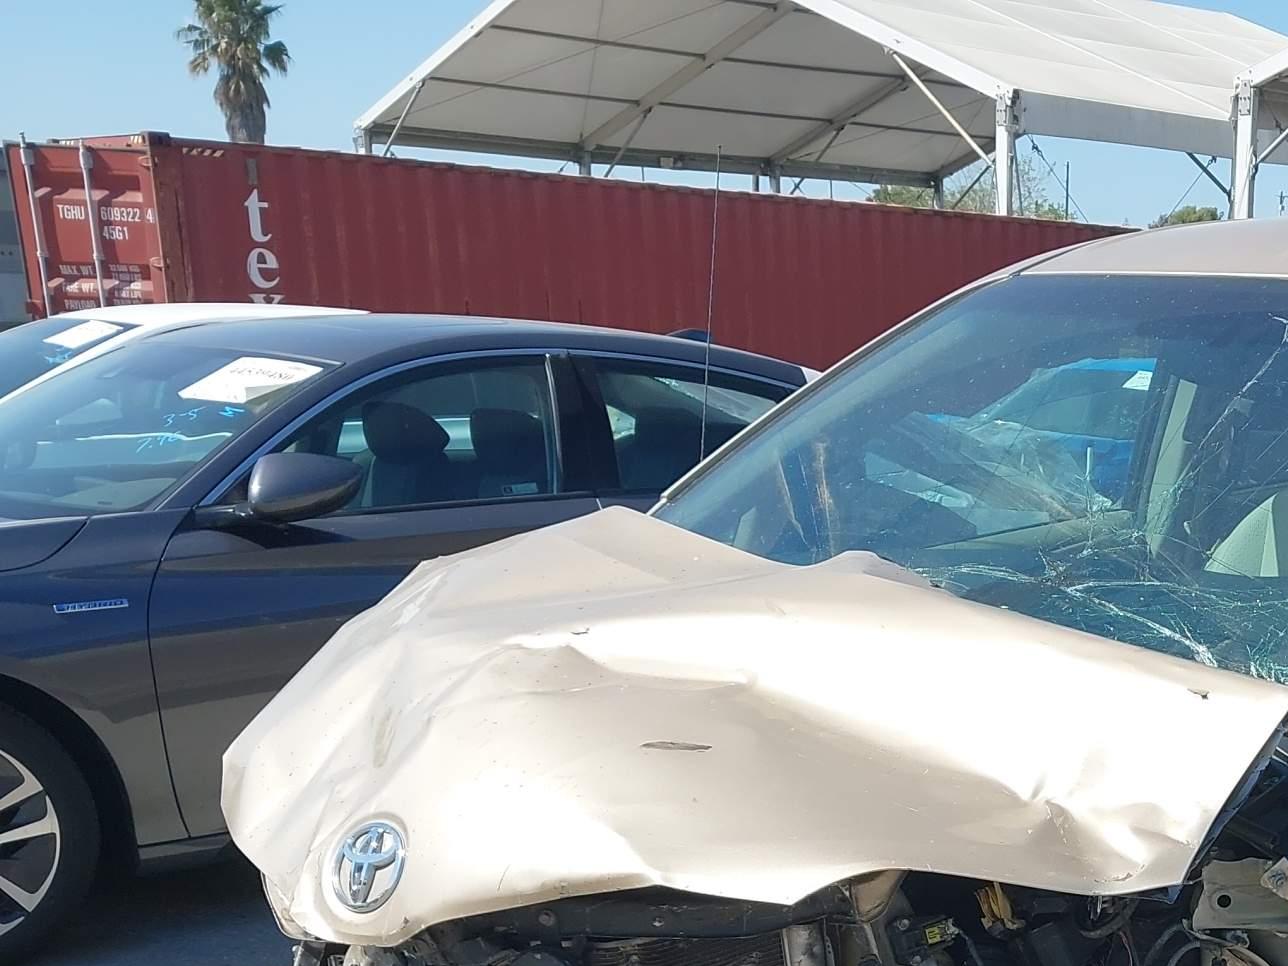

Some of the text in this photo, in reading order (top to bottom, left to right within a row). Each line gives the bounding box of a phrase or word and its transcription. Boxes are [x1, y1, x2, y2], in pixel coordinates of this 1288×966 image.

[56, 204, 155, 223] TGHU 609322 4
[102, 225, 129, 240] 45G1
